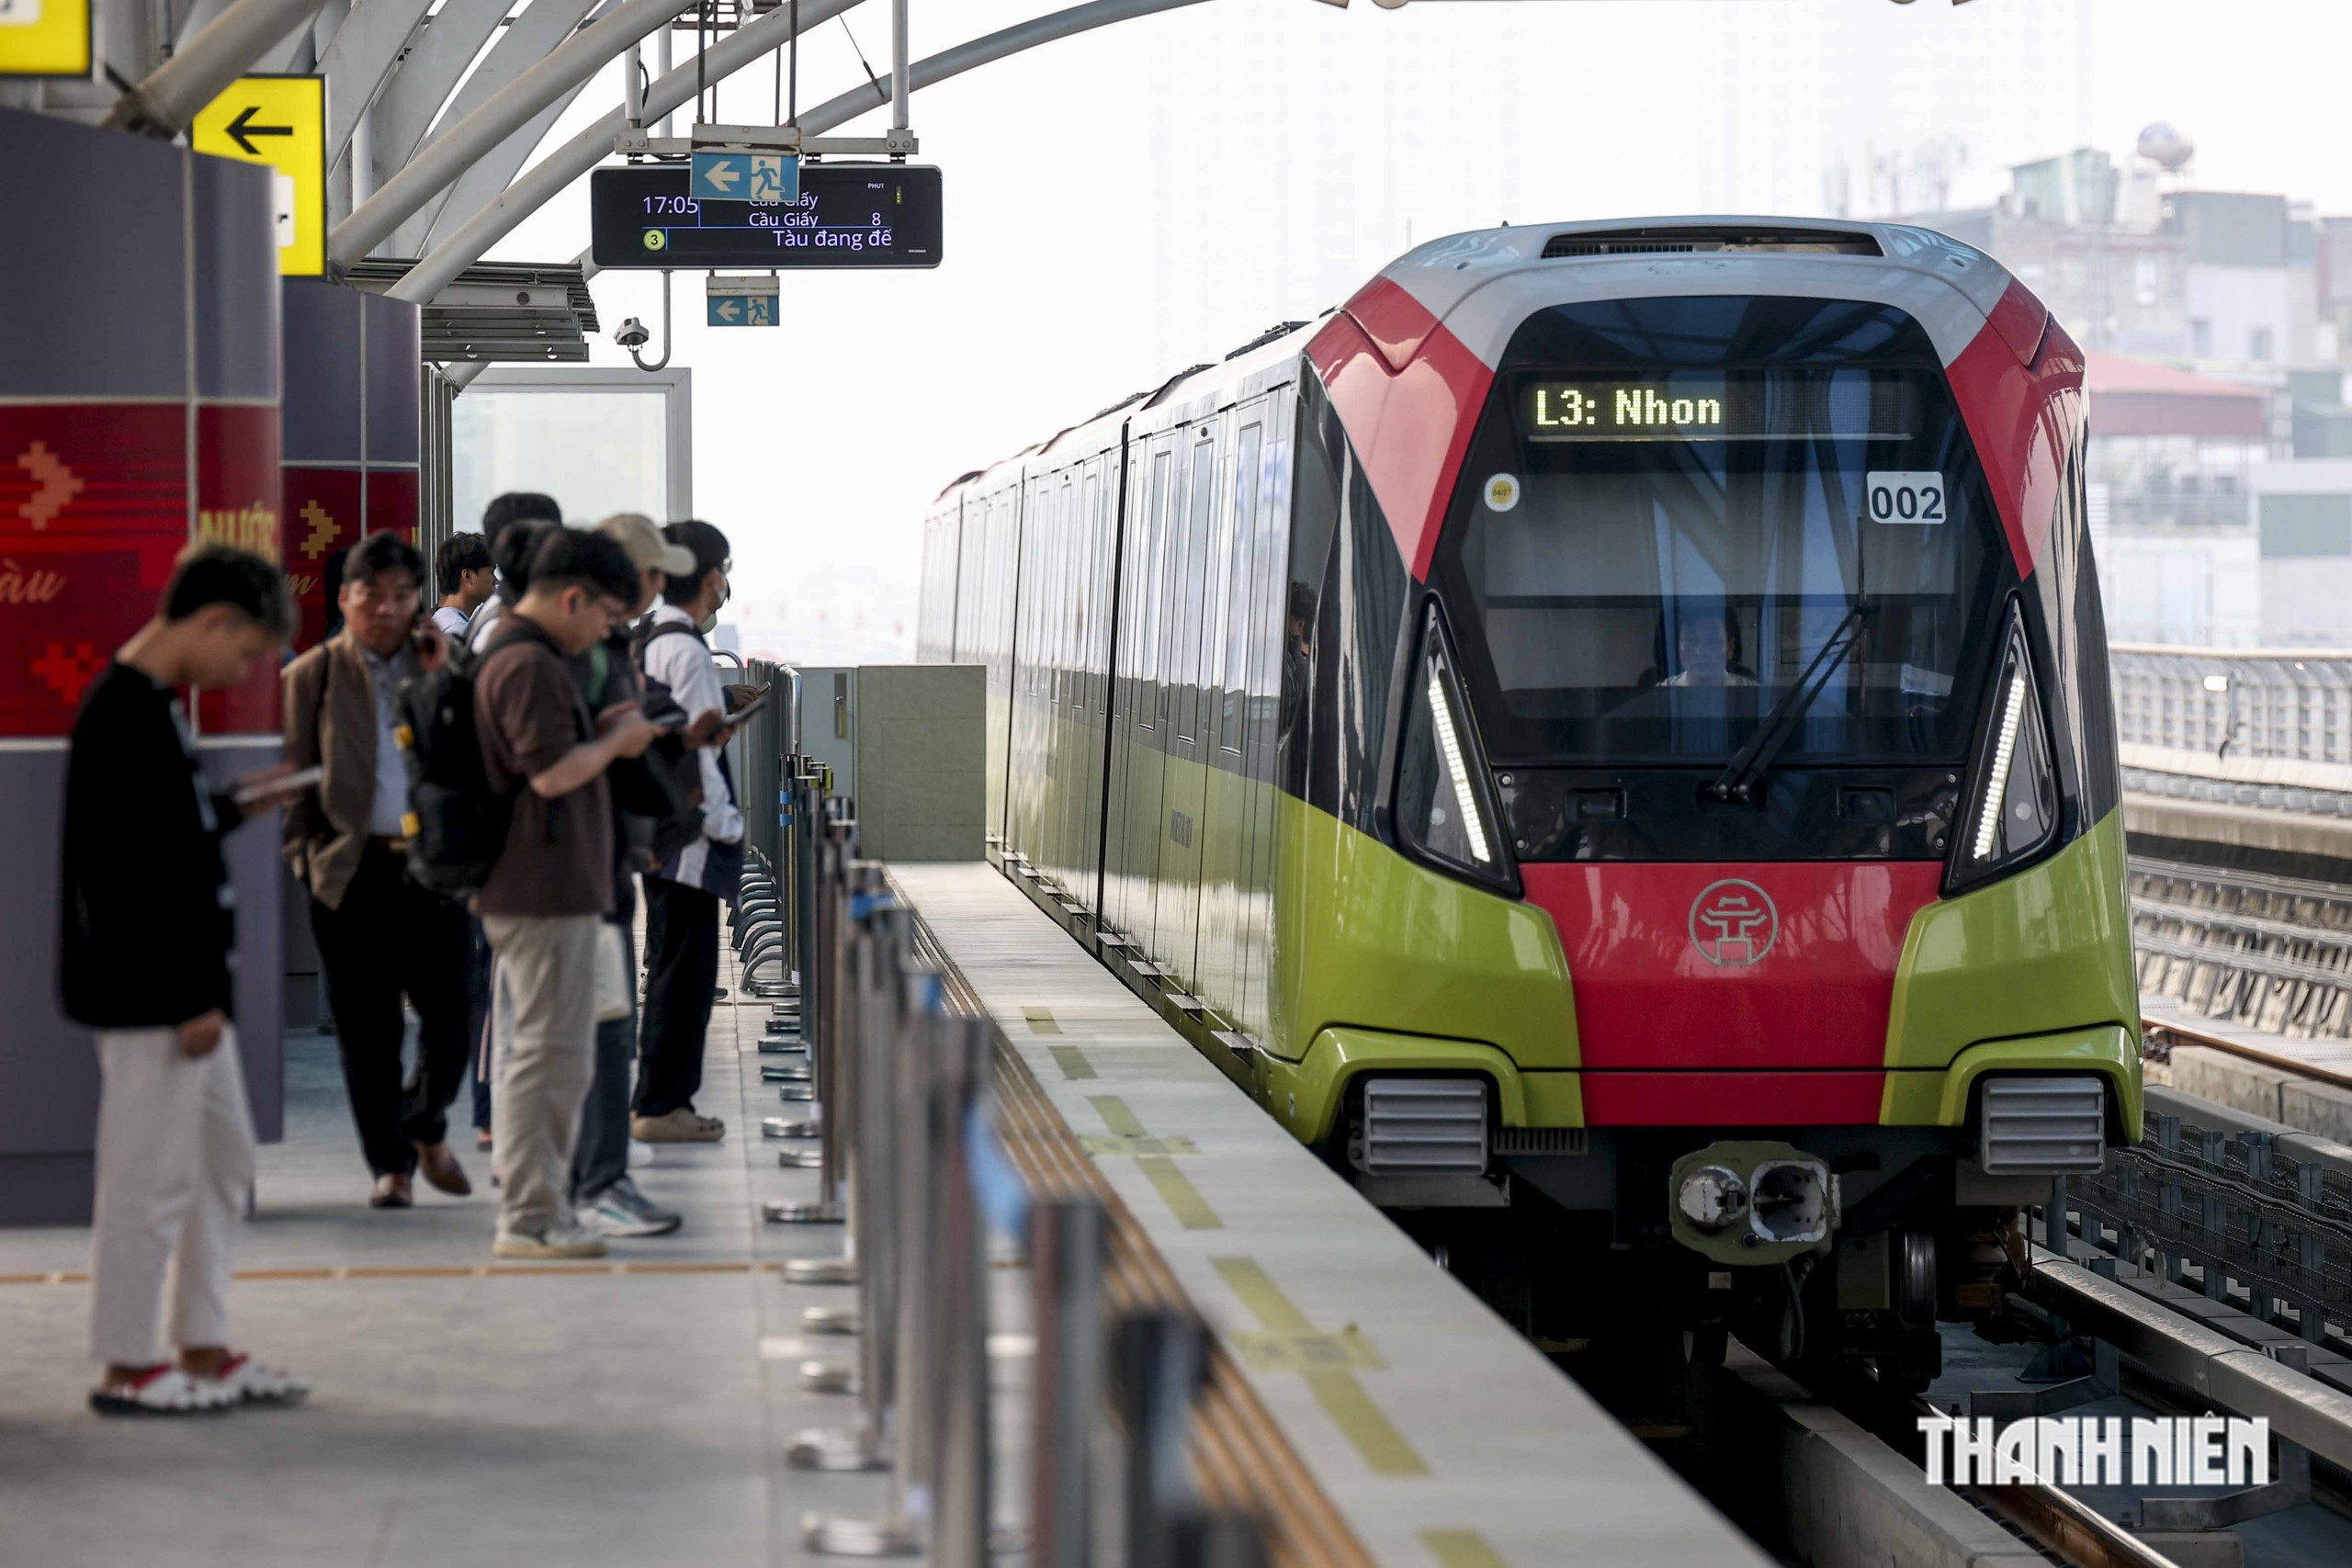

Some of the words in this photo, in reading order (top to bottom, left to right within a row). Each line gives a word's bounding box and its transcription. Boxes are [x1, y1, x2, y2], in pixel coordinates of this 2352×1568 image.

[643, 196, 698, 213] 17:05
[749, 211, 779, 226] Cầu
[784, 211, 819, 228] Giấy
[872, 212, 881, 226] 8
[650, 234, 659, 245] 3
[773, 229, 808, 246] Tàu
[814, 229, 863, 251] đang
[1537, 389, 1595, 425] L3:
[1616, 389, 1720, 425] Nhon
[1871, 486, 1943, 520] 002
